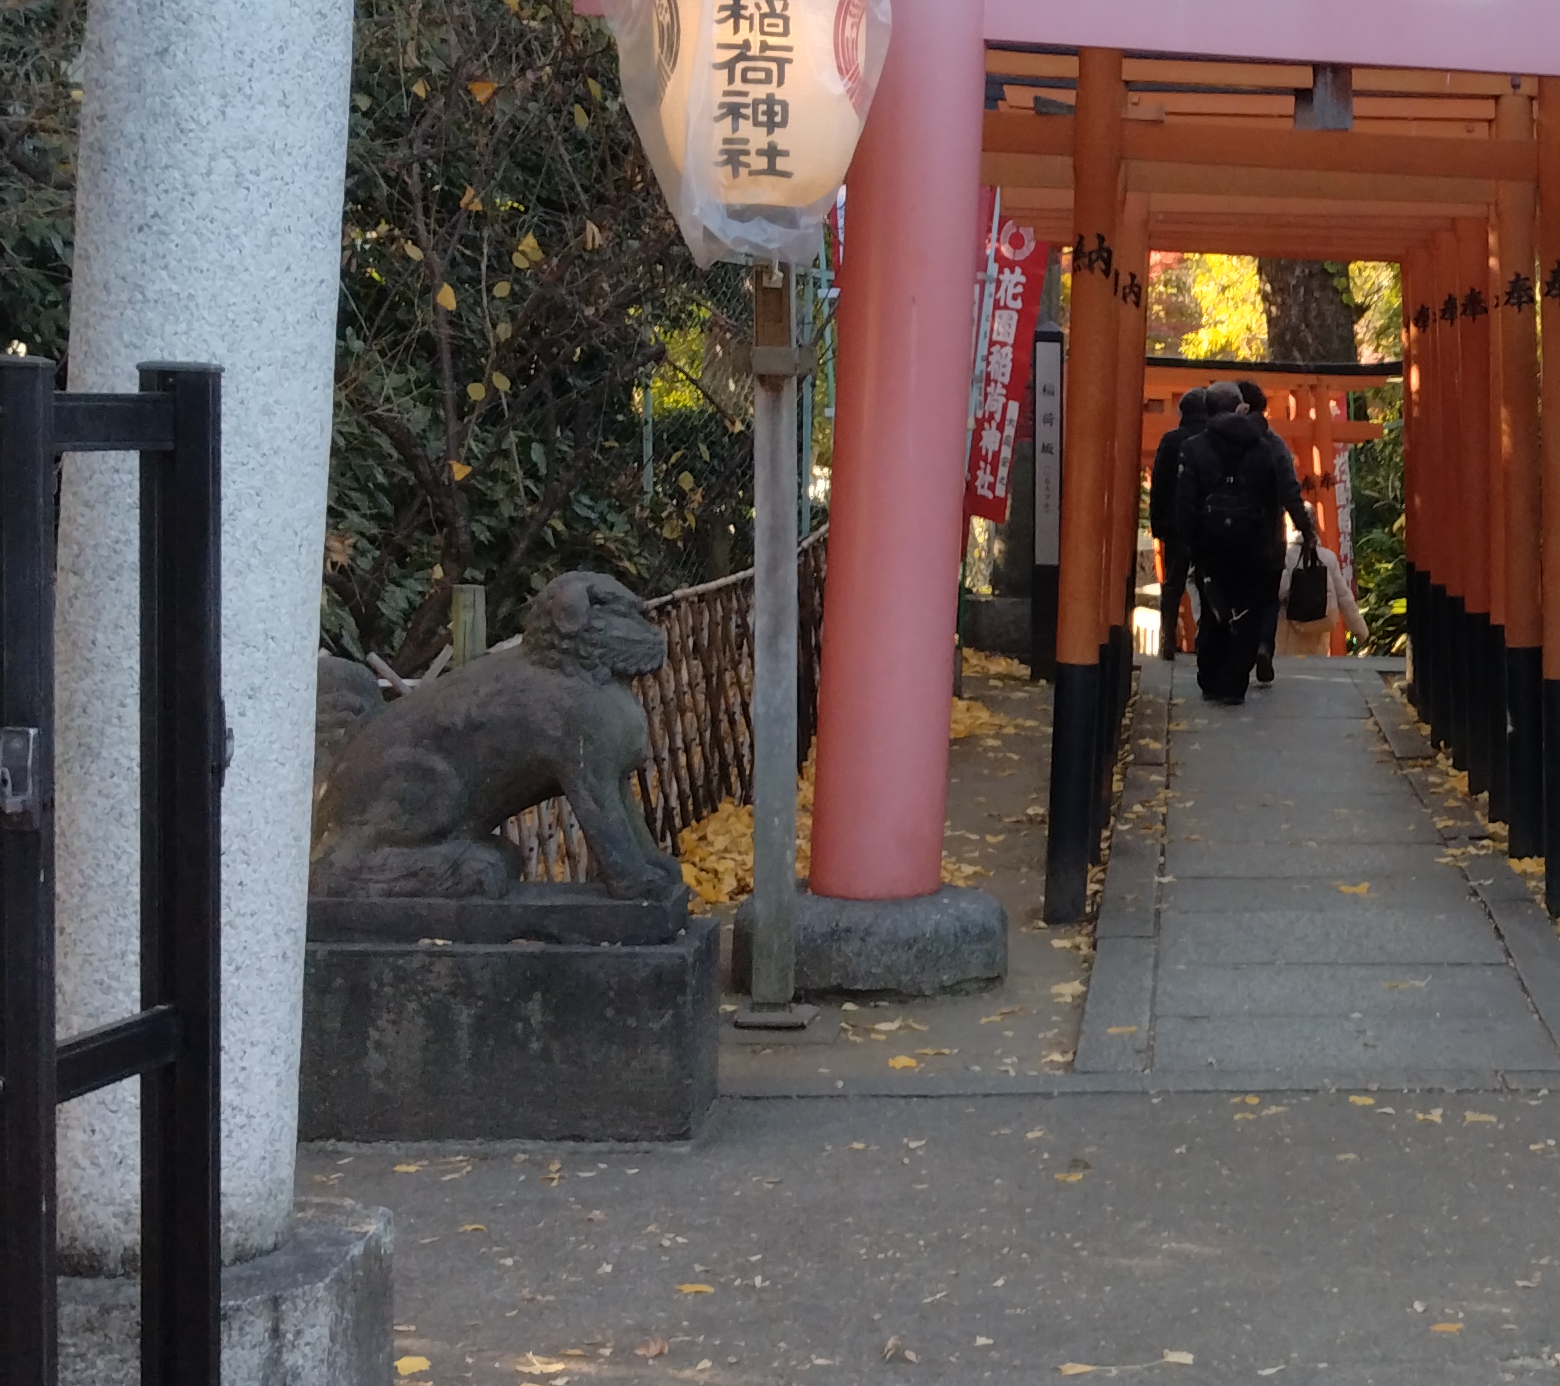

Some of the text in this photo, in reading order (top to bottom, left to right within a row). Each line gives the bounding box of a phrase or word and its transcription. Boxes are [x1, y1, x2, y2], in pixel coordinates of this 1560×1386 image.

[1504, 272, 1535, 314] 奉
[974, 266, 1027, 500] 花園稲荷神社
